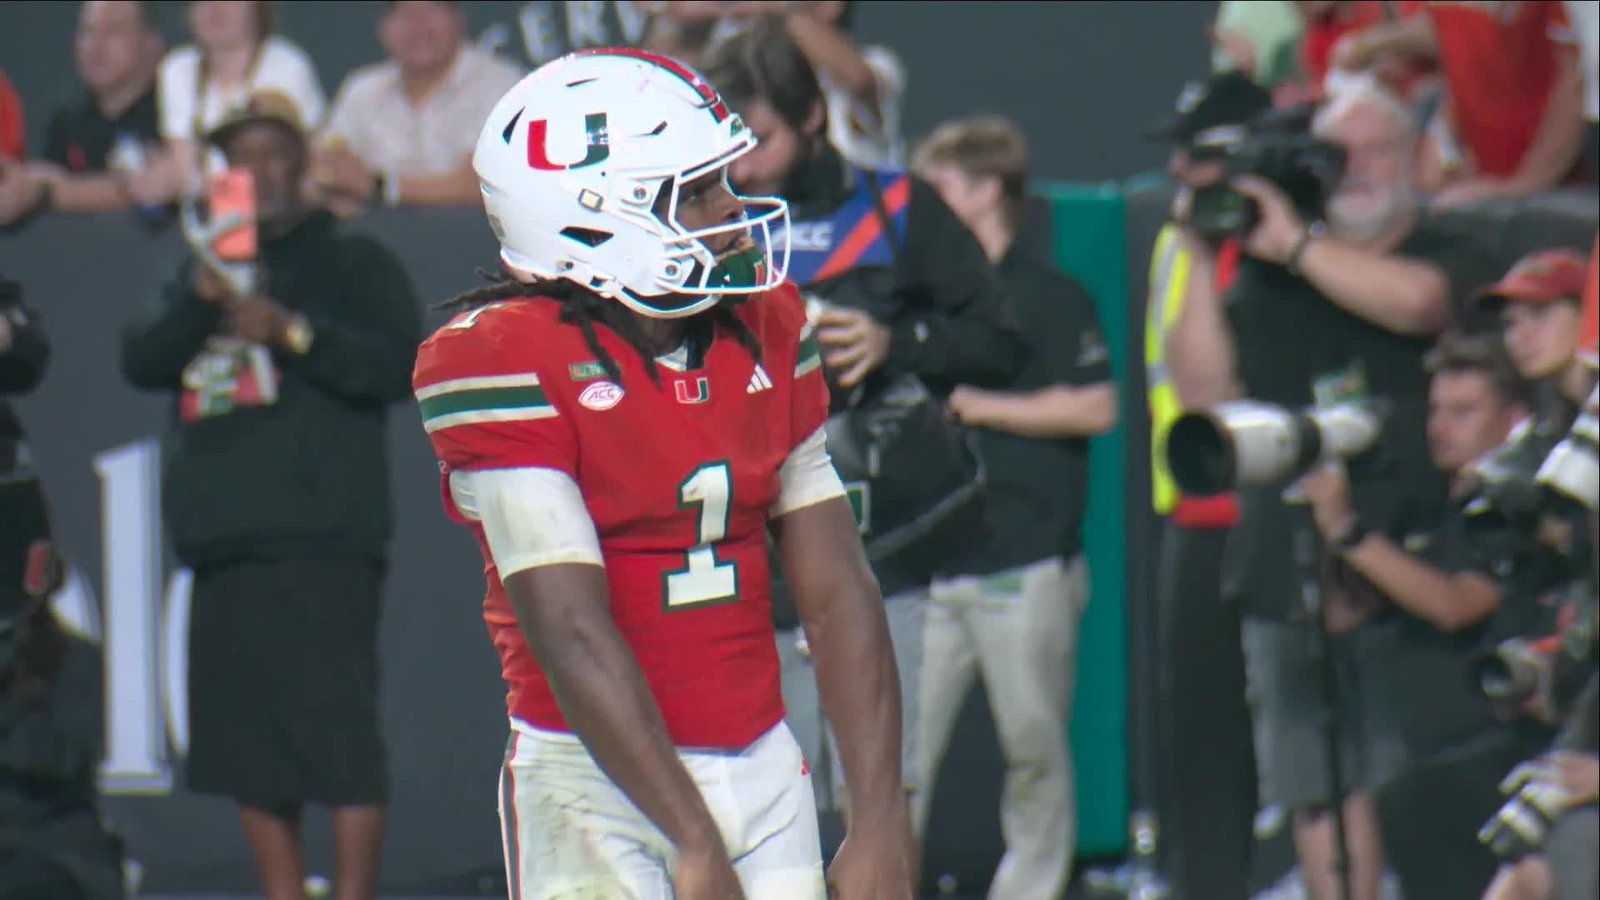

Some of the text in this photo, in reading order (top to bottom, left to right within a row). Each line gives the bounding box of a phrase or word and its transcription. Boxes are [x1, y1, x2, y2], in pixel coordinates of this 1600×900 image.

[527, 112, 609, 170] U
[674, 376, 709, 404] U
[661, 459, 741, 613] 1
